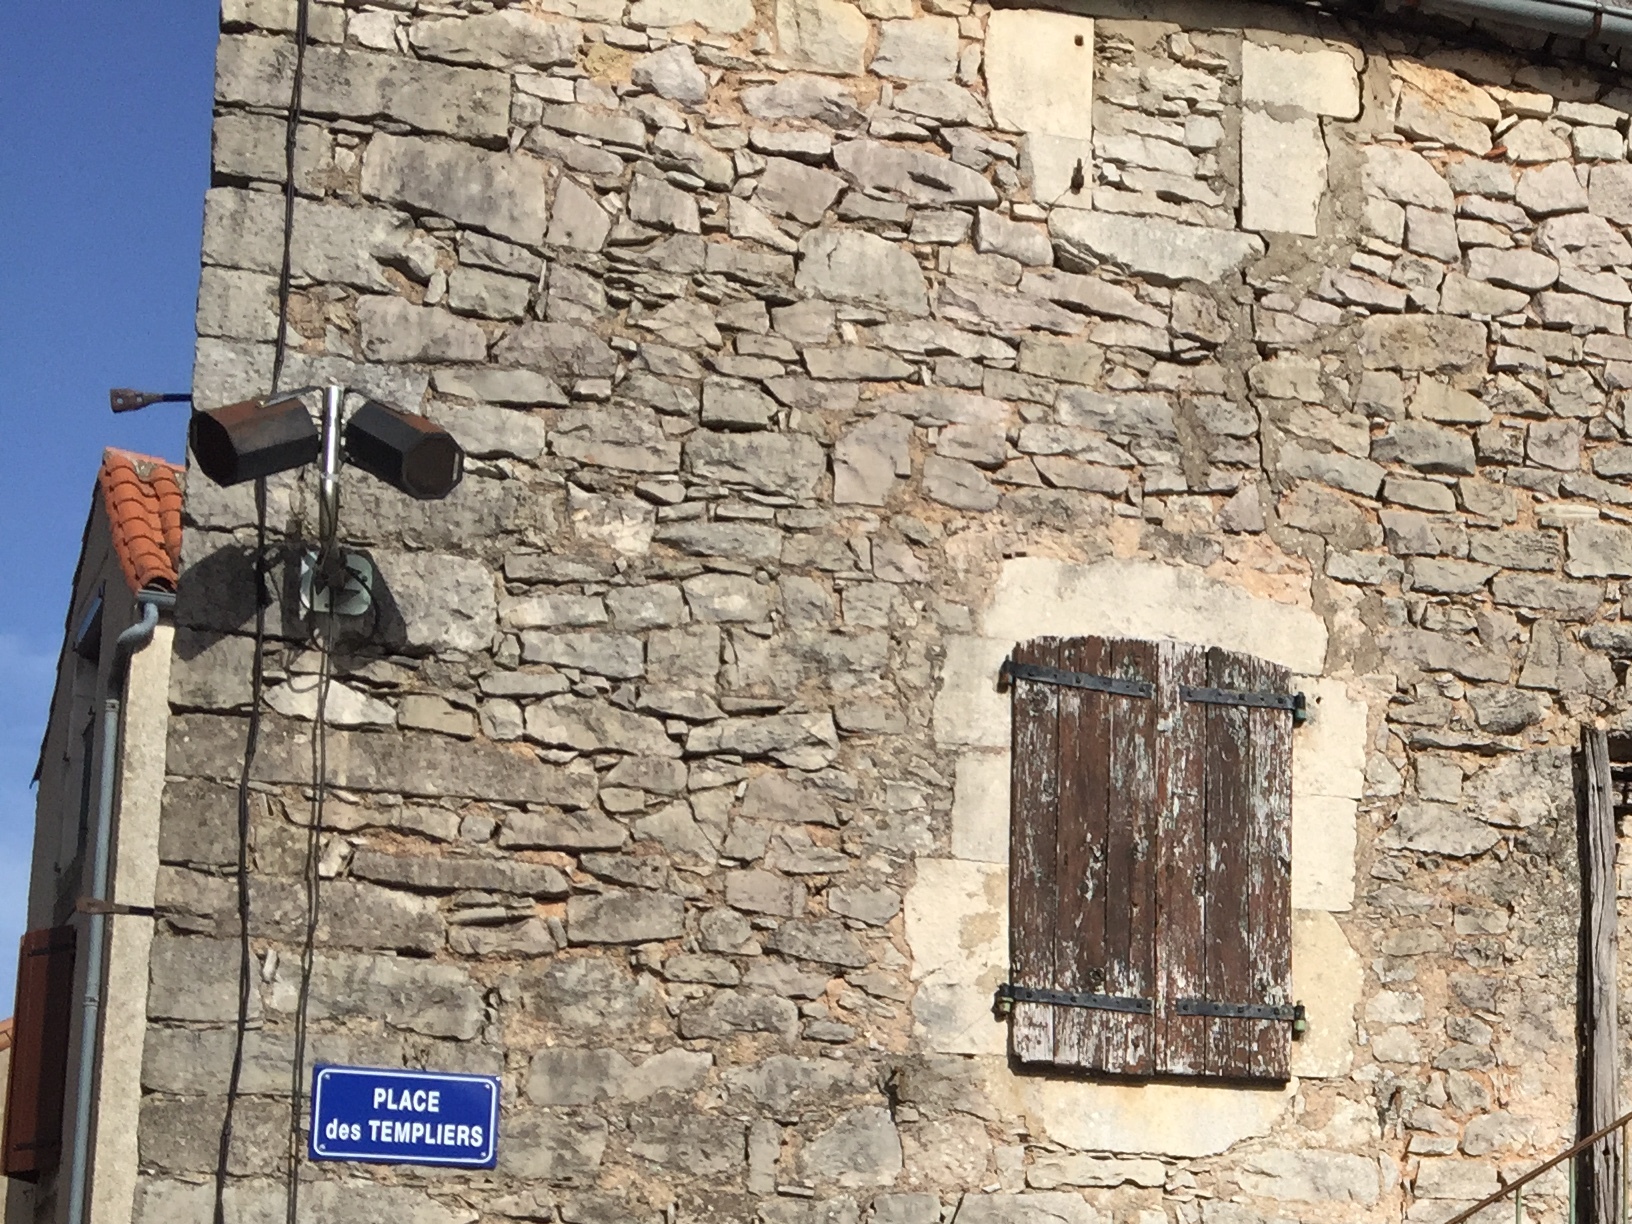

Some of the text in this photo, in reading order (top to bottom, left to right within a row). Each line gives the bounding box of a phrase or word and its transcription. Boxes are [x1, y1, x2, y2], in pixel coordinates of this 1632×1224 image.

[373, 1087, 440, 1113] PLACE
[325, 1118, 484, 1148] des TEMPLIERS
